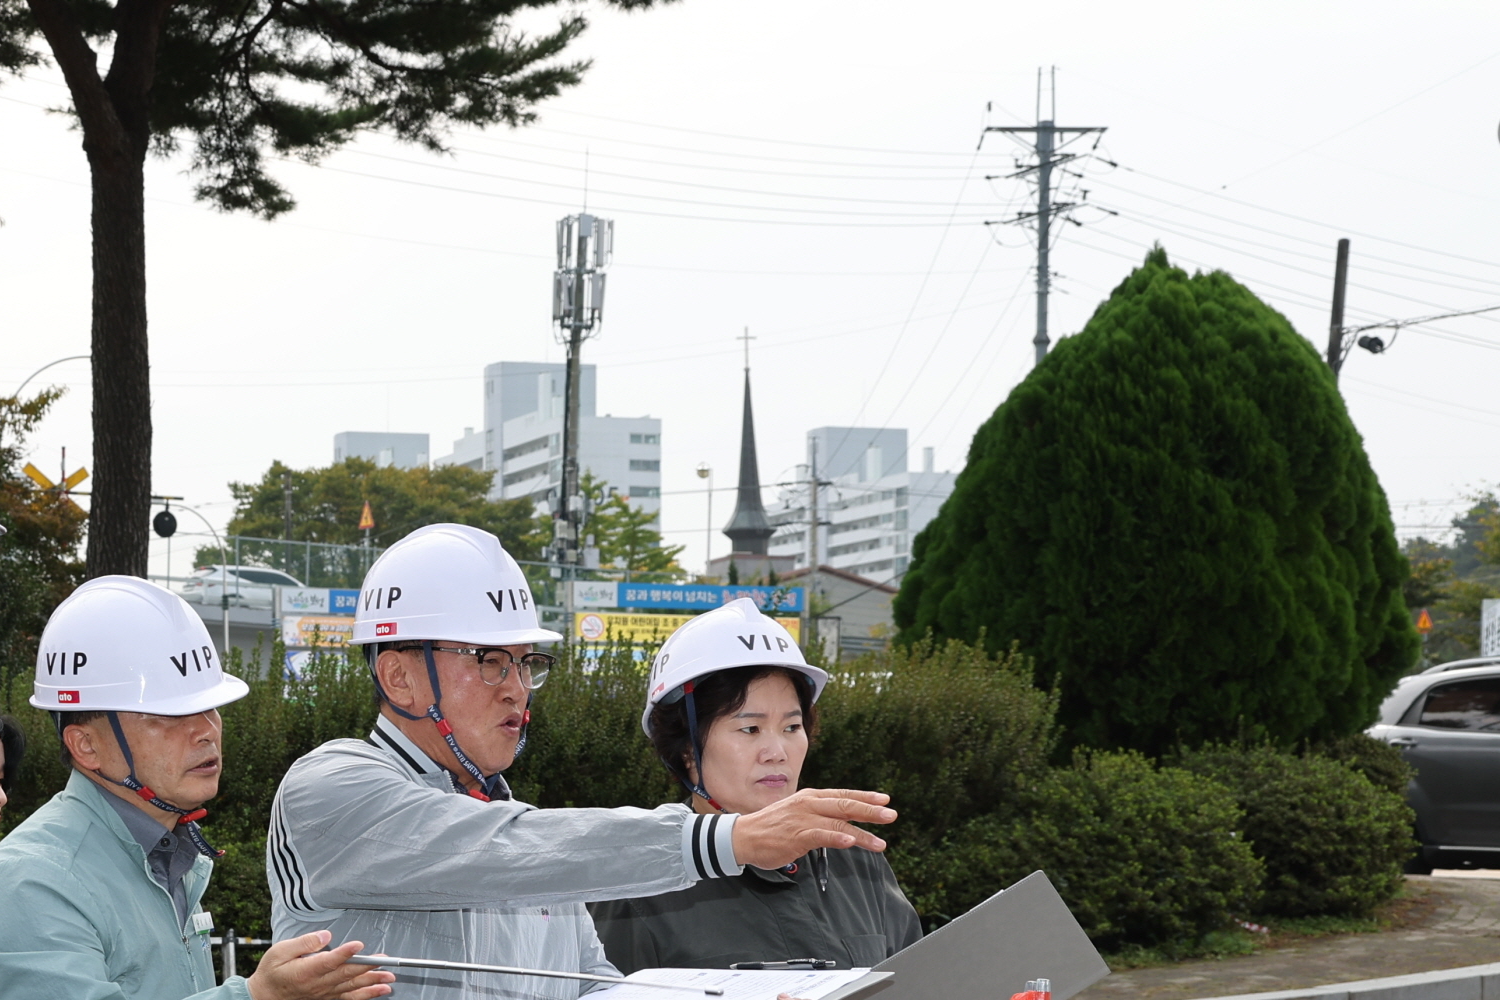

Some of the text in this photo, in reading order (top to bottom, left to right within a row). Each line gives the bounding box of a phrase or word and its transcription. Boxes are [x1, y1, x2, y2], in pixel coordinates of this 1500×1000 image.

[365, 586, 402, 612] VIP
[486, 588, 528, 612] VIP
[626, 589, 648, 601] 꿈과
[650, 590, 683, 602] 행복이
[685, 591, 717, 603] 넘치는
[376, 625, 390, 634] ato
[737, 634, 789, 652] VIP
[46, 652, 88, 675] VIP
[170, 645, 212, 677] VIP
[653, 653, 670, 680] IP
[59, 693, 72, 701] ato
